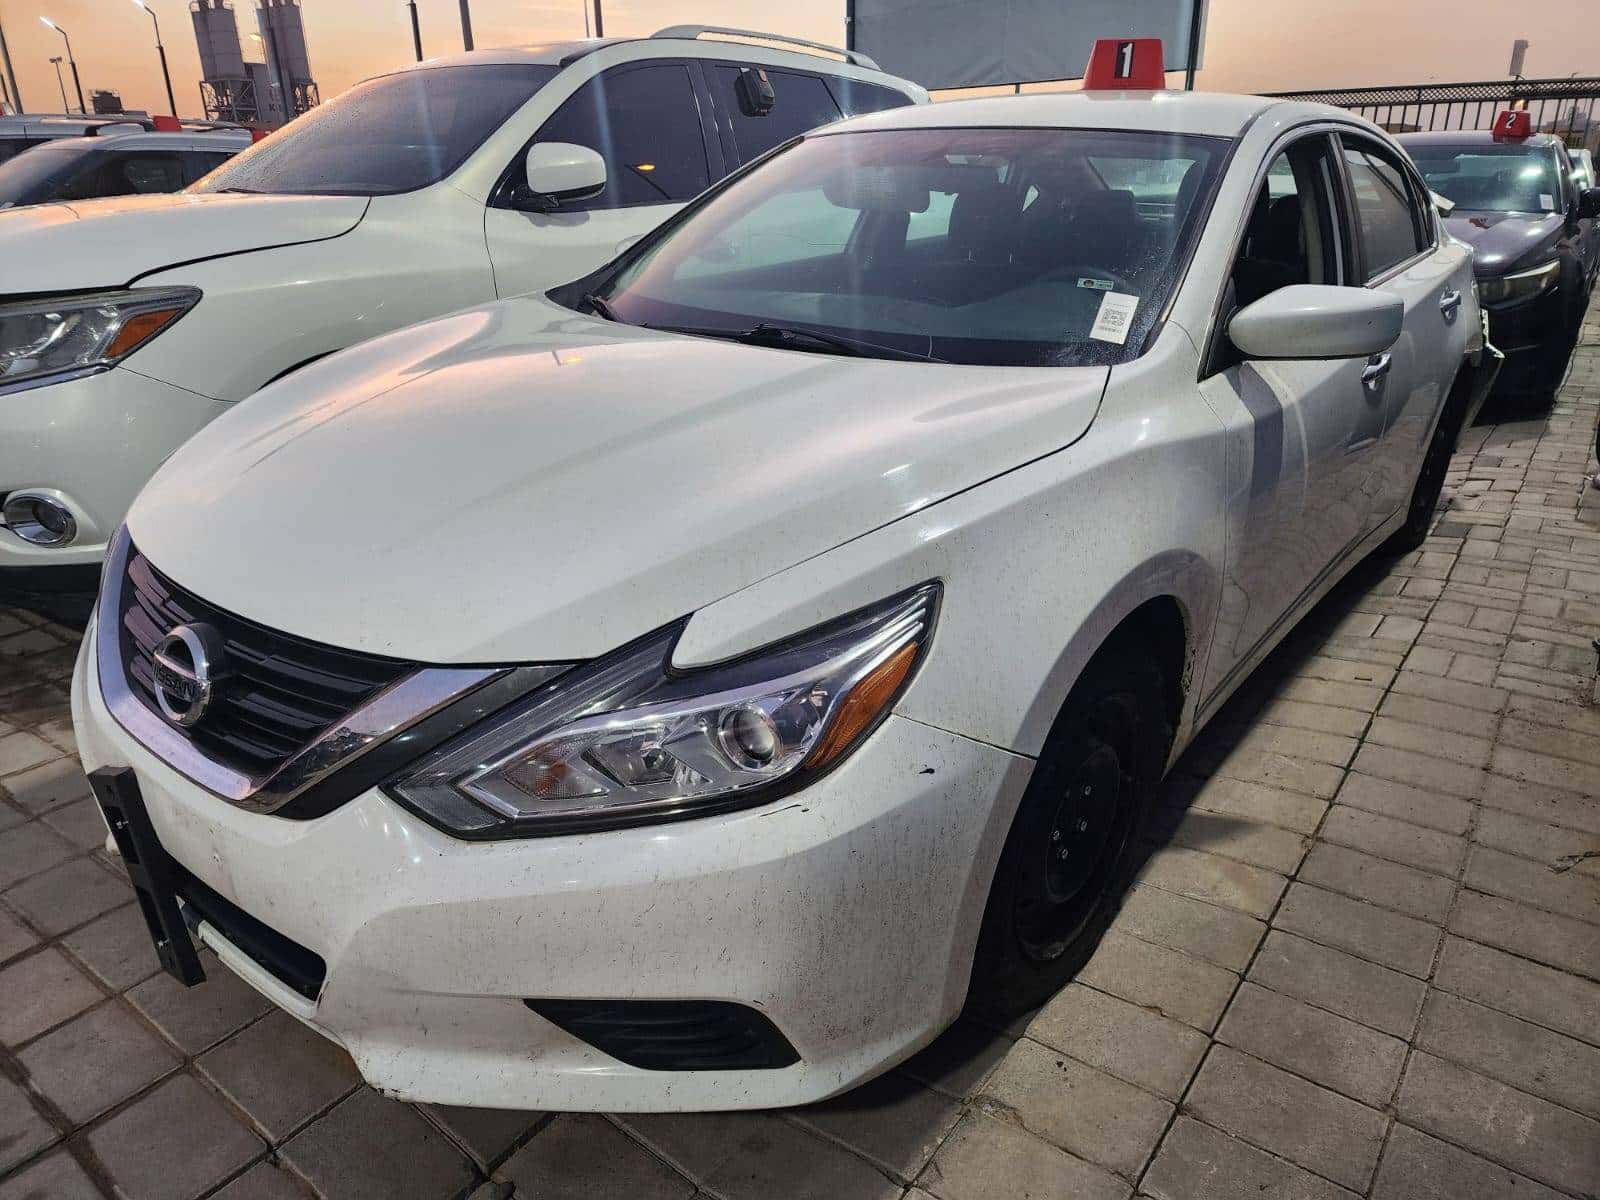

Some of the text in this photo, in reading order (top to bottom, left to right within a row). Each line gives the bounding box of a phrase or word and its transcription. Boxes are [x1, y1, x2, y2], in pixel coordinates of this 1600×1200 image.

[1121, 42, 1133, 78] 1
[1505, 112, 1517, 129] 2
[153, 660, 197, 700] NISSAN
